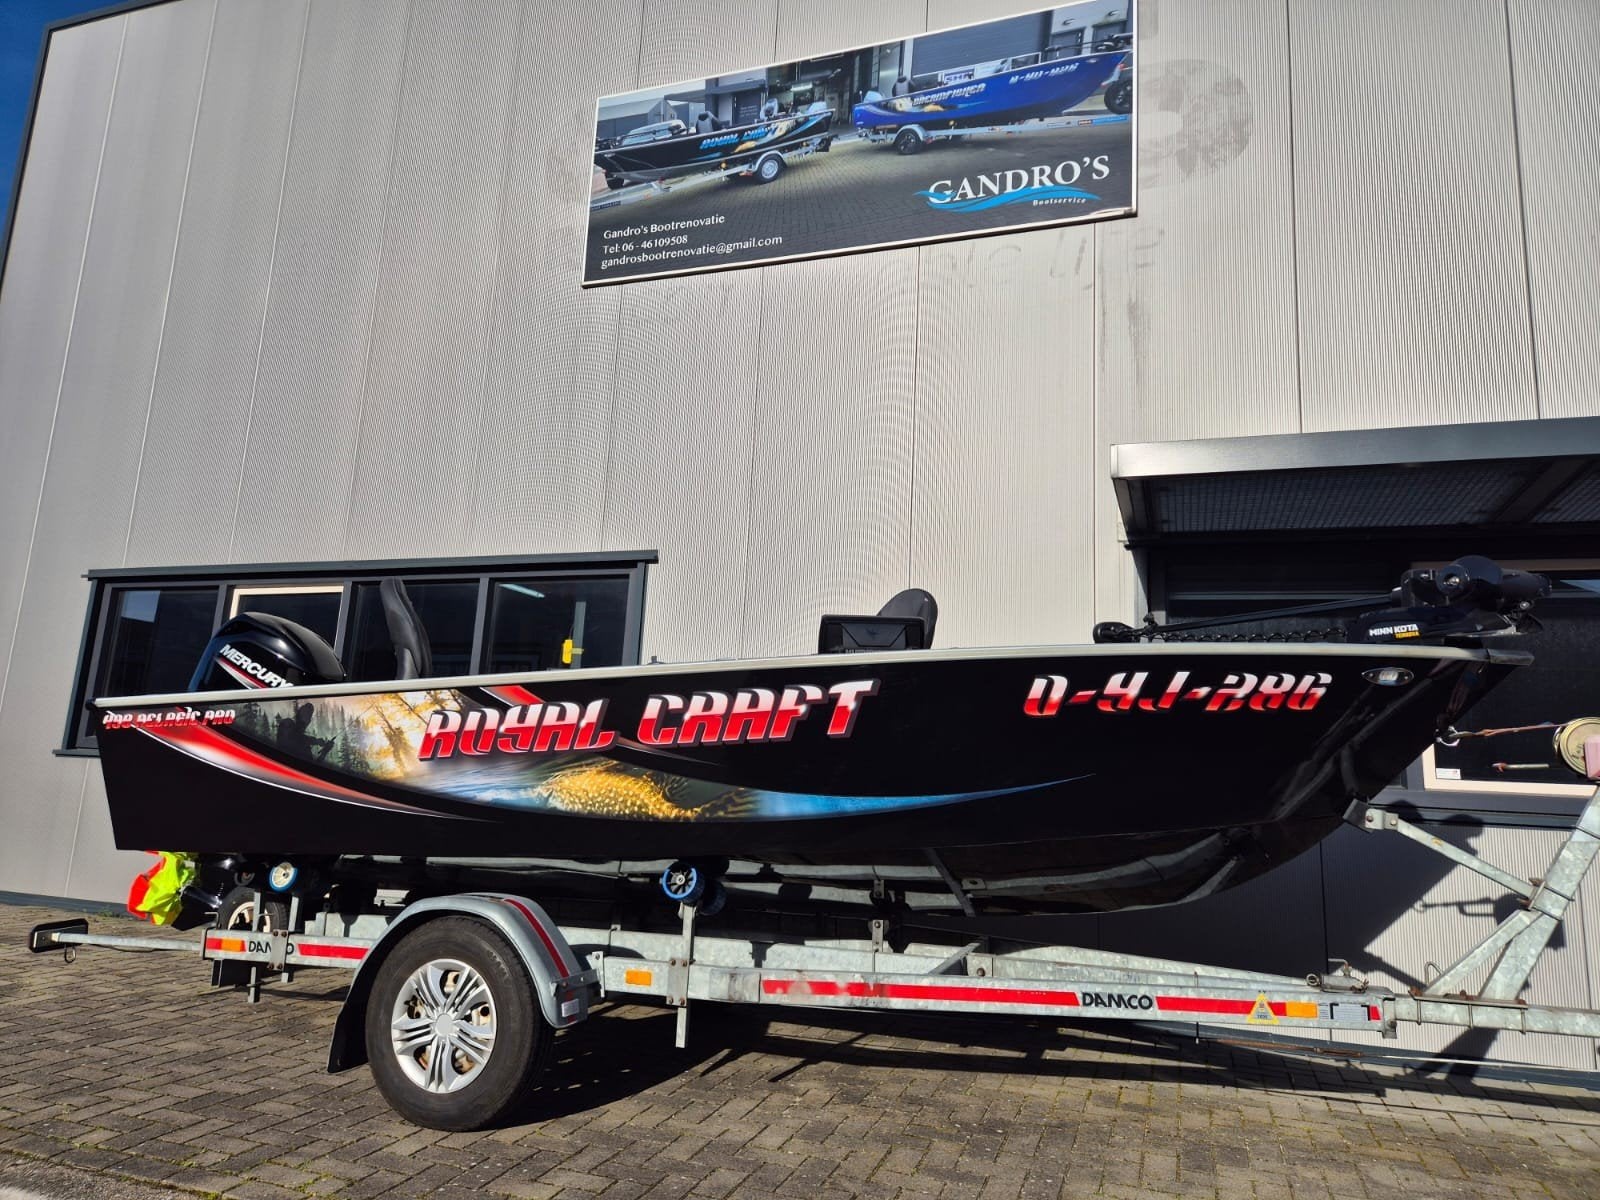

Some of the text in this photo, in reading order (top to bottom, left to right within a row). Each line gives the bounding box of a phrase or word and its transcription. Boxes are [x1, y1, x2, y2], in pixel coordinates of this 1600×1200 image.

[928, 155, 1110, 203] GANDRO'S
[1032, 197, 1086, 206] Bootservice
[603, 213, 725, 239] Gandro's Bootrenovatie
[601, 236, 783, 269] gandrosbootrenovatie@gmail.com
[602, 244, 621, 255] Tel:
[622, 242, 634, 252] 06
[641, 235, 688, 249] 46109508
[1369, 627, 1393, 636] MINN
[1394, 624, 1419, 633] KOTA
[220, 644, 294, 687] MERCURY
[418, 679, 878, 759] ROYAL CRAFT
[248, 941, 295, 955] DAMO
[1082, 992, 1153, 1010] DAMCO
